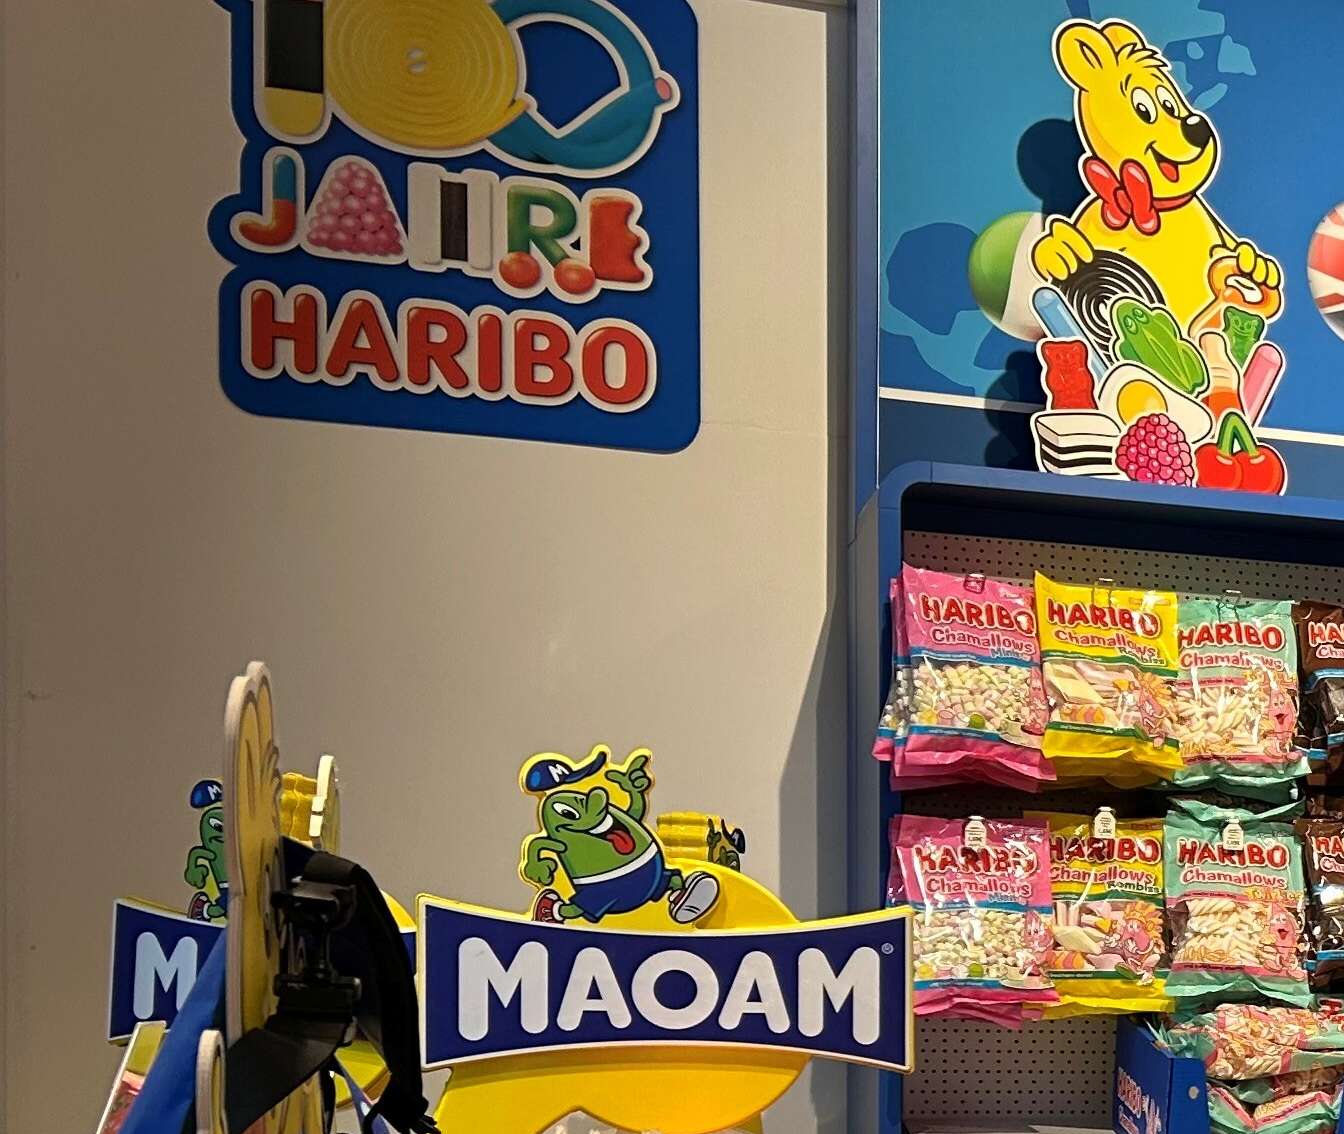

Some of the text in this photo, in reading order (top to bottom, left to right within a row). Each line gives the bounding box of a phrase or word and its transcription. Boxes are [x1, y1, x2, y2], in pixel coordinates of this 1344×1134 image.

[236, 150, 648, 294] JAHRE
[250, 287, 650, 404] HARIBO
[922, 596, 1036, 638] HARIBO
[1047, 599, 1160, 638] HARIBO
[931, 627, 1034, 662] Chamallows
[1178, 625, 1286, 657] HARIBO
[1178, 838, 1289, 872] HARIBO
[1182, 865, 1288, 898] Chamallows
[459, 936, 880, 1045] MAOAM
